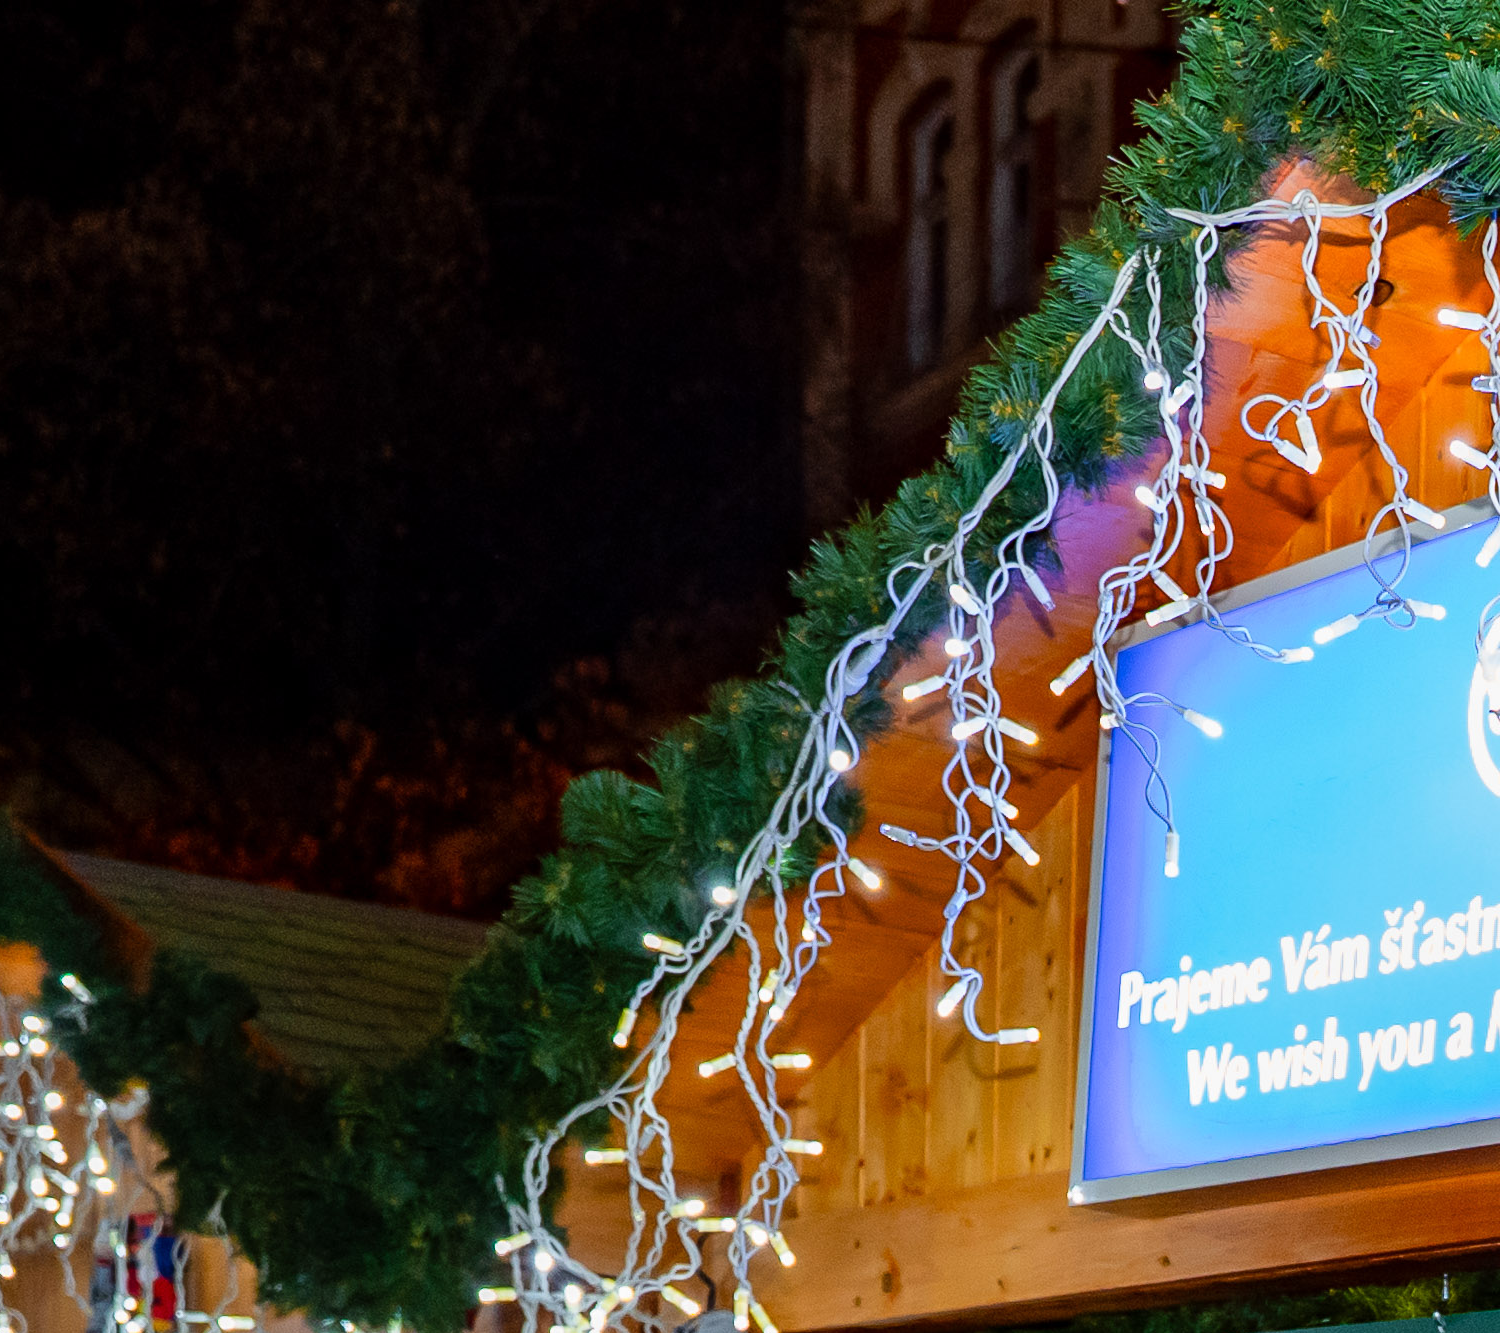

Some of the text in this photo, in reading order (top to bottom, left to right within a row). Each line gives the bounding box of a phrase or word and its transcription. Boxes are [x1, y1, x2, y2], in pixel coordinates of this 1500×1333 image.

[1117, 955, 1271, 1033] Prajeme
[1280, 923, 1370, 993] Vám
[1186, 1042, 1250, 1106] We
[1257, 1016, 1349, 1093] wish
[1358, 1018, 1437, 1092] you
[1445, 1011, 1474, 1060] a
